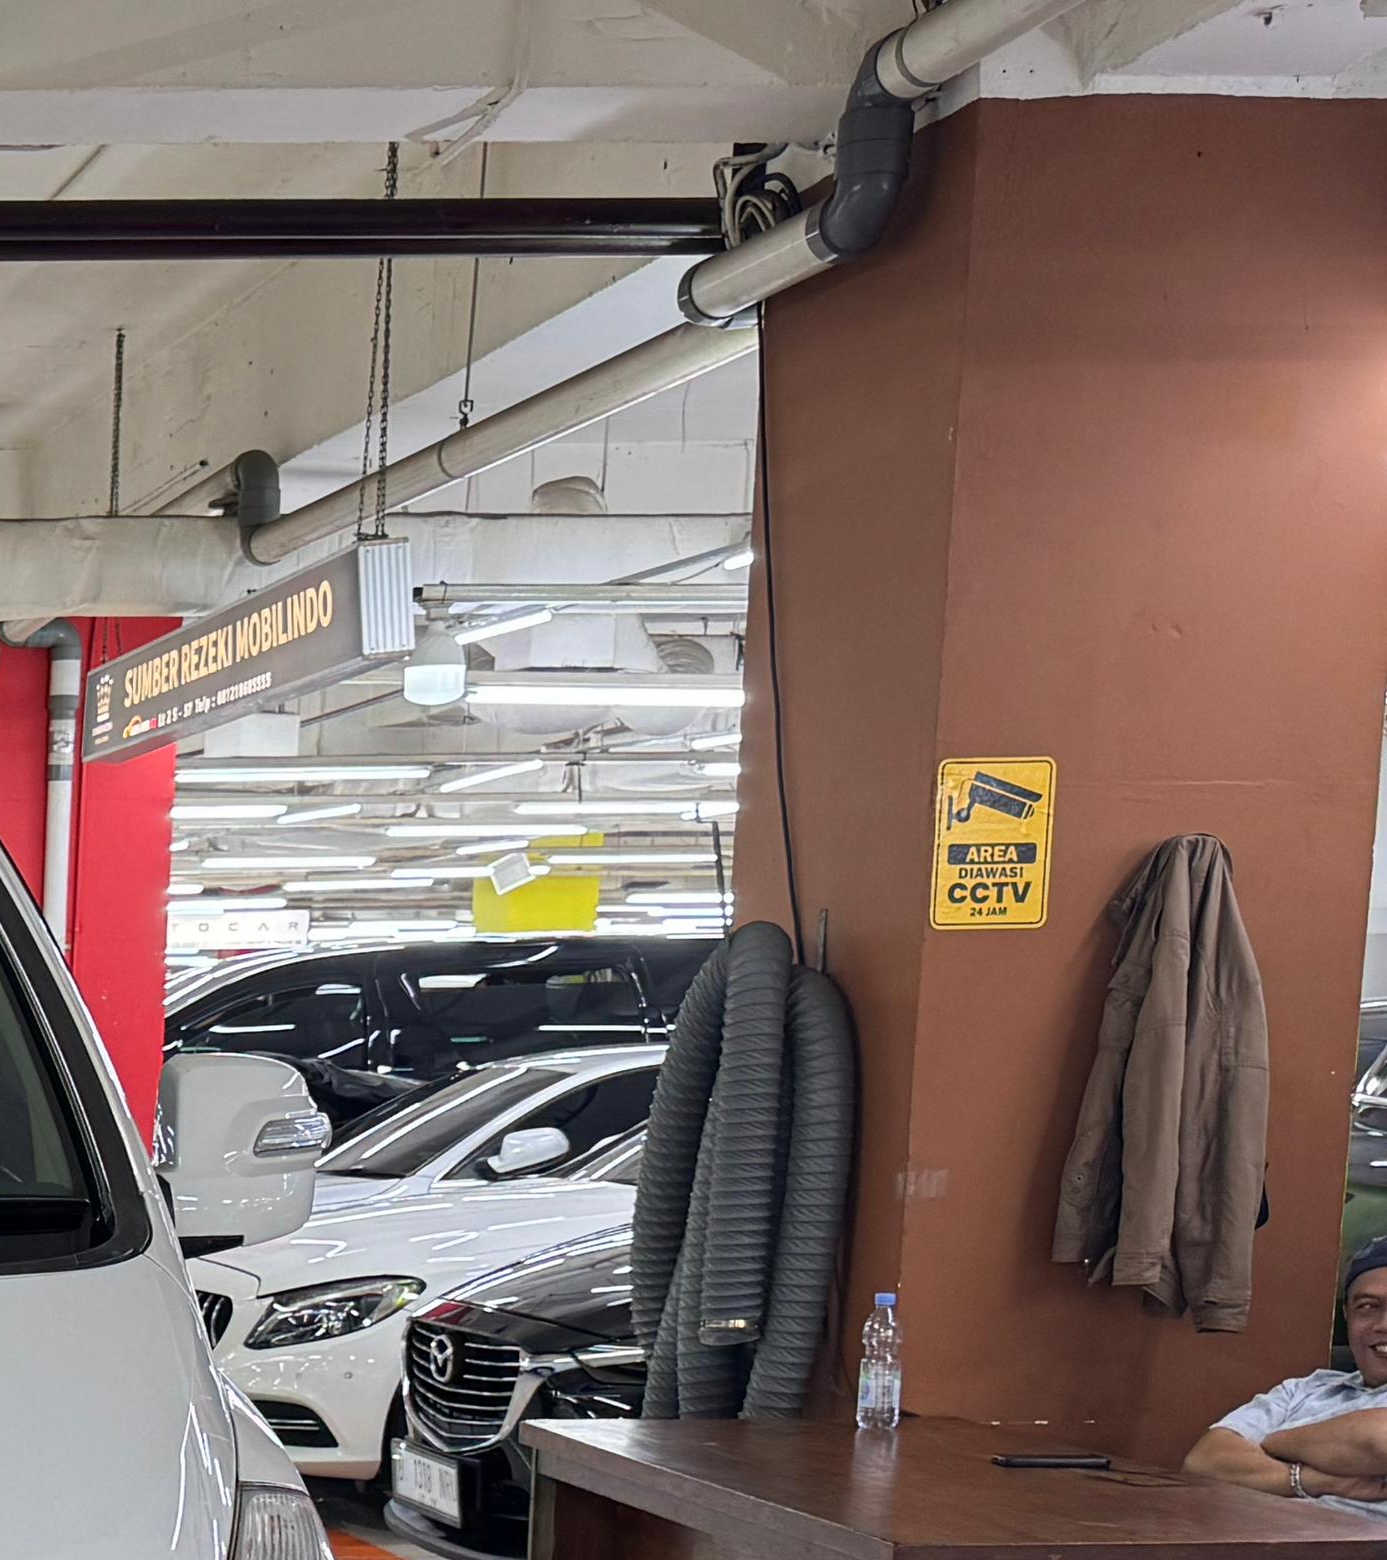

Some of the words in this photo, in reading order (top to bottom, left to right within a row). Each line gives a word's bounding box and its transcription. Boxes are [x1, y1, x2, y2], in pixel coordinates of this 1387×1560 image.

[123, 649, 180, 708] SUMBER
[180, 624, 233, 685] REZEKI
[235, 579, 333, 663] MOBILINDO
[965, 845, 1018, 862] AREA
[958, 866, 1024, 879] DIAWASI
[947, 880, 1033, 904] CCTV
[970, 906, 983, 917] 24
[985, 906, 1008, 917] JAM
